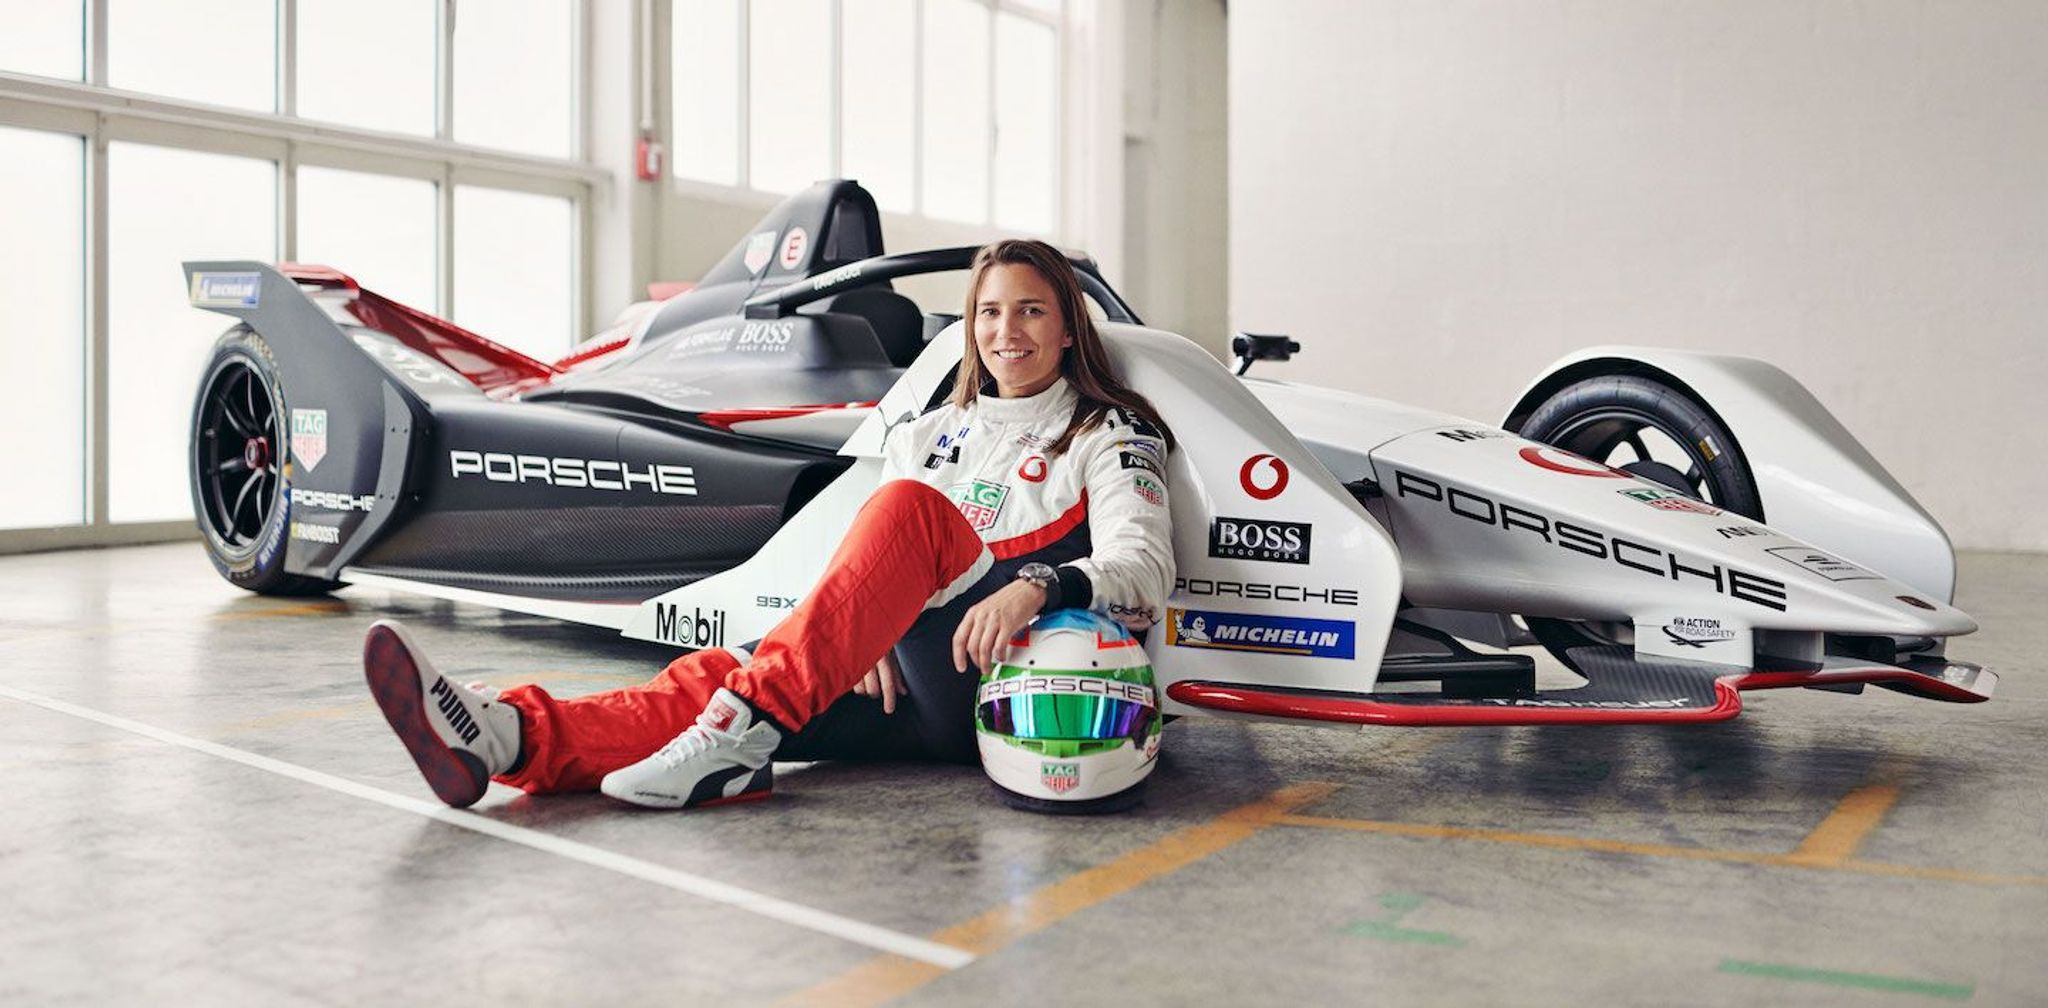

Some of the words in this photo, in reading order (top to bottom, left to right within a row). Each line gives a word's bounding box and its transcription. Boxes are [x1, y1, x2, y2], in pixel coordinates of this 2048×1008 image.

[739, 322, 794, 344] BOSS
[295, 414, 323, 434] TAG
[936, 427, 970, 449] Mil
[449, 449, 699, 497] PORSCHE
[291, 487, 376, 512] PORSCHE
[1217, 521, 1301, 551] BOSS
[1395, 469, 1787, 612] PORSCHE
[1218, 548, 1255, 558] HUGO
[1263, 550, 1300, 561] BOSS
[756, 595, 798, 609] 99X
[655, 602, 726, 649] Mobil
[1685, 627, 1706, 637] ROAD
[1706, 629, 1736, 638] SAFETY
[1686, 618, 1721, 629] ACTION
[1213, 624, 1340, 648] MICHELIN
[987, 678, 1144, 701] PORSCHE
[430, 675, 482, 747] PUMA
[1044, 764, 1076, 777] TAG
